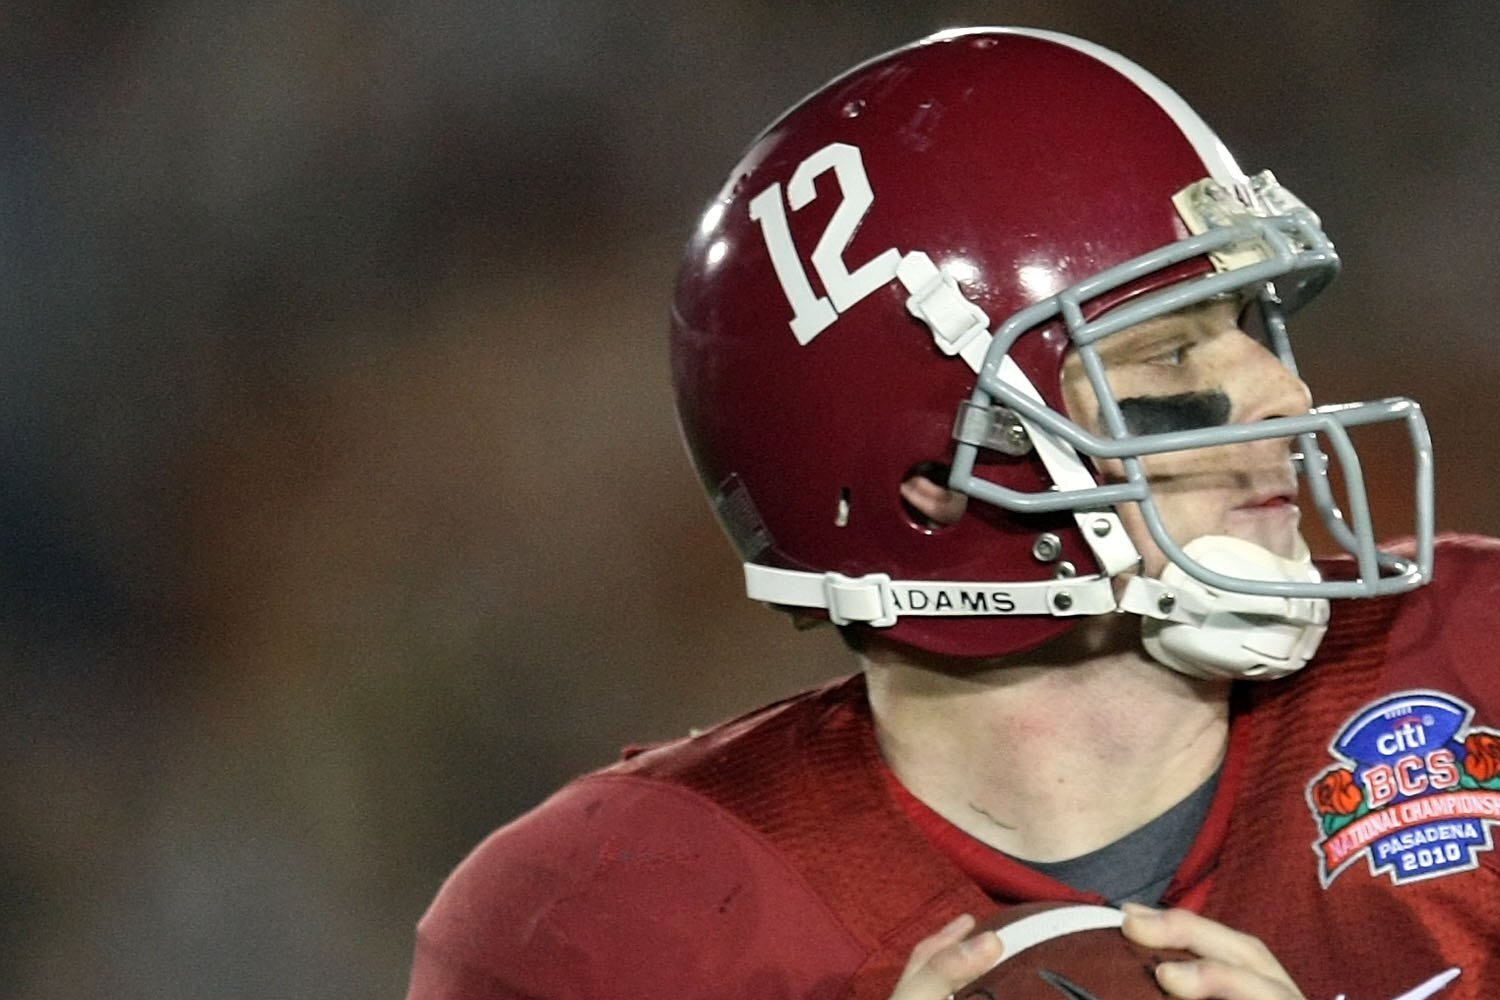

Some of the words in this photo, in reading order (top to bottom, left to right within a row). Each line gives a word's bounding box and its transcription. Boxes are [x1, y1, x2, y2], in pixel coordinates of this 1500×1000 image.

[749, 142, 902, 346] 12
[1377, 722, 1427, 756] citi
[1362, 748, 1460, 809] BCS
[1328, 810, 1400, 861] NATIONAL
[1378, 822, 1479, 860] PASADENA
[1401, 843, 1462, 872] 2010
